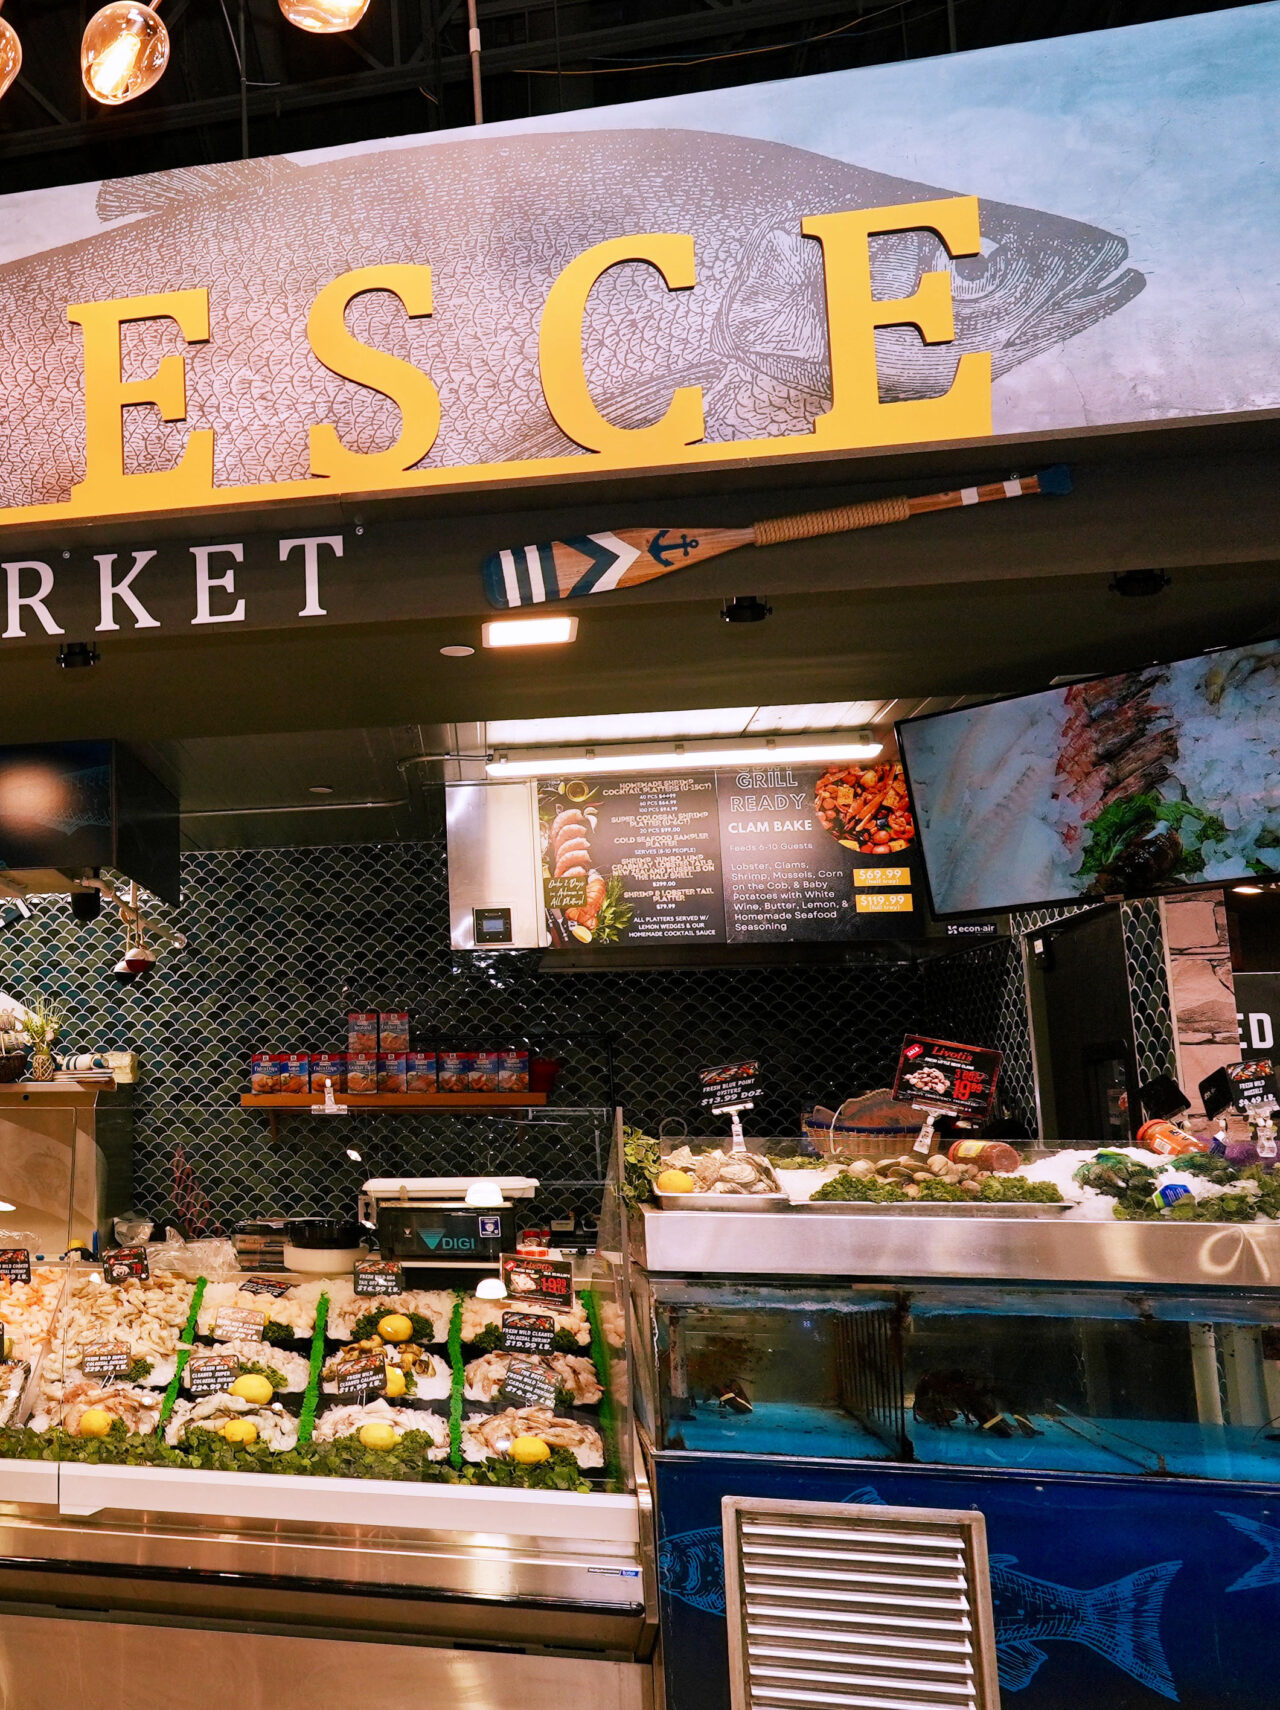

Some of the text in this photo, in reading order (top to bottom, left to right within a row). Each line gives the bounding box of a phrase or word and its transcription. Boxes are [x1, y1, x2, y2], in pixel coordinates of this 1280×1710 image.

[736, 771, 798, 789] GRILL
[602, 788, 641, 796] COCKTAIL
[730, 793, 806, 812] READY
[728, 820, 812, 833] CLAM BAKE
[729, 844, 756, 852] Feeds
[780, 842, 813, 850] Guests
[731, 861, 809, 871] Lobster, Clams,
[732, 870, 843, 882] Shrimp, Mussels, Corn
[859, 869, 902, 880] $69.99
[748, 882, 764, 890] the
[767, 881, 791, 890] Cob,
[793, 881, 800, 889] &
[803, 880, 828, 890] Baby
[733, 890, 835, 900] Potatoes with White
[734, 903, 762, 911] Wine,
[765, 901, 800, 910] Butter,
[802, 900, 839, 909] Lemon,
[860, 896, 905, 906] $119.99
[734, 910, 837, 921] Homemade Seafood
[735, 922, 787, 932] Seasoning
[738, 1078, 755, 1086] POINT
[717, 1087, 741, 1096] OYSTERS
[701, 1089, 764, 1106] $13.99 DOZ.
[442, 1238, 475, 1249] DIGI
